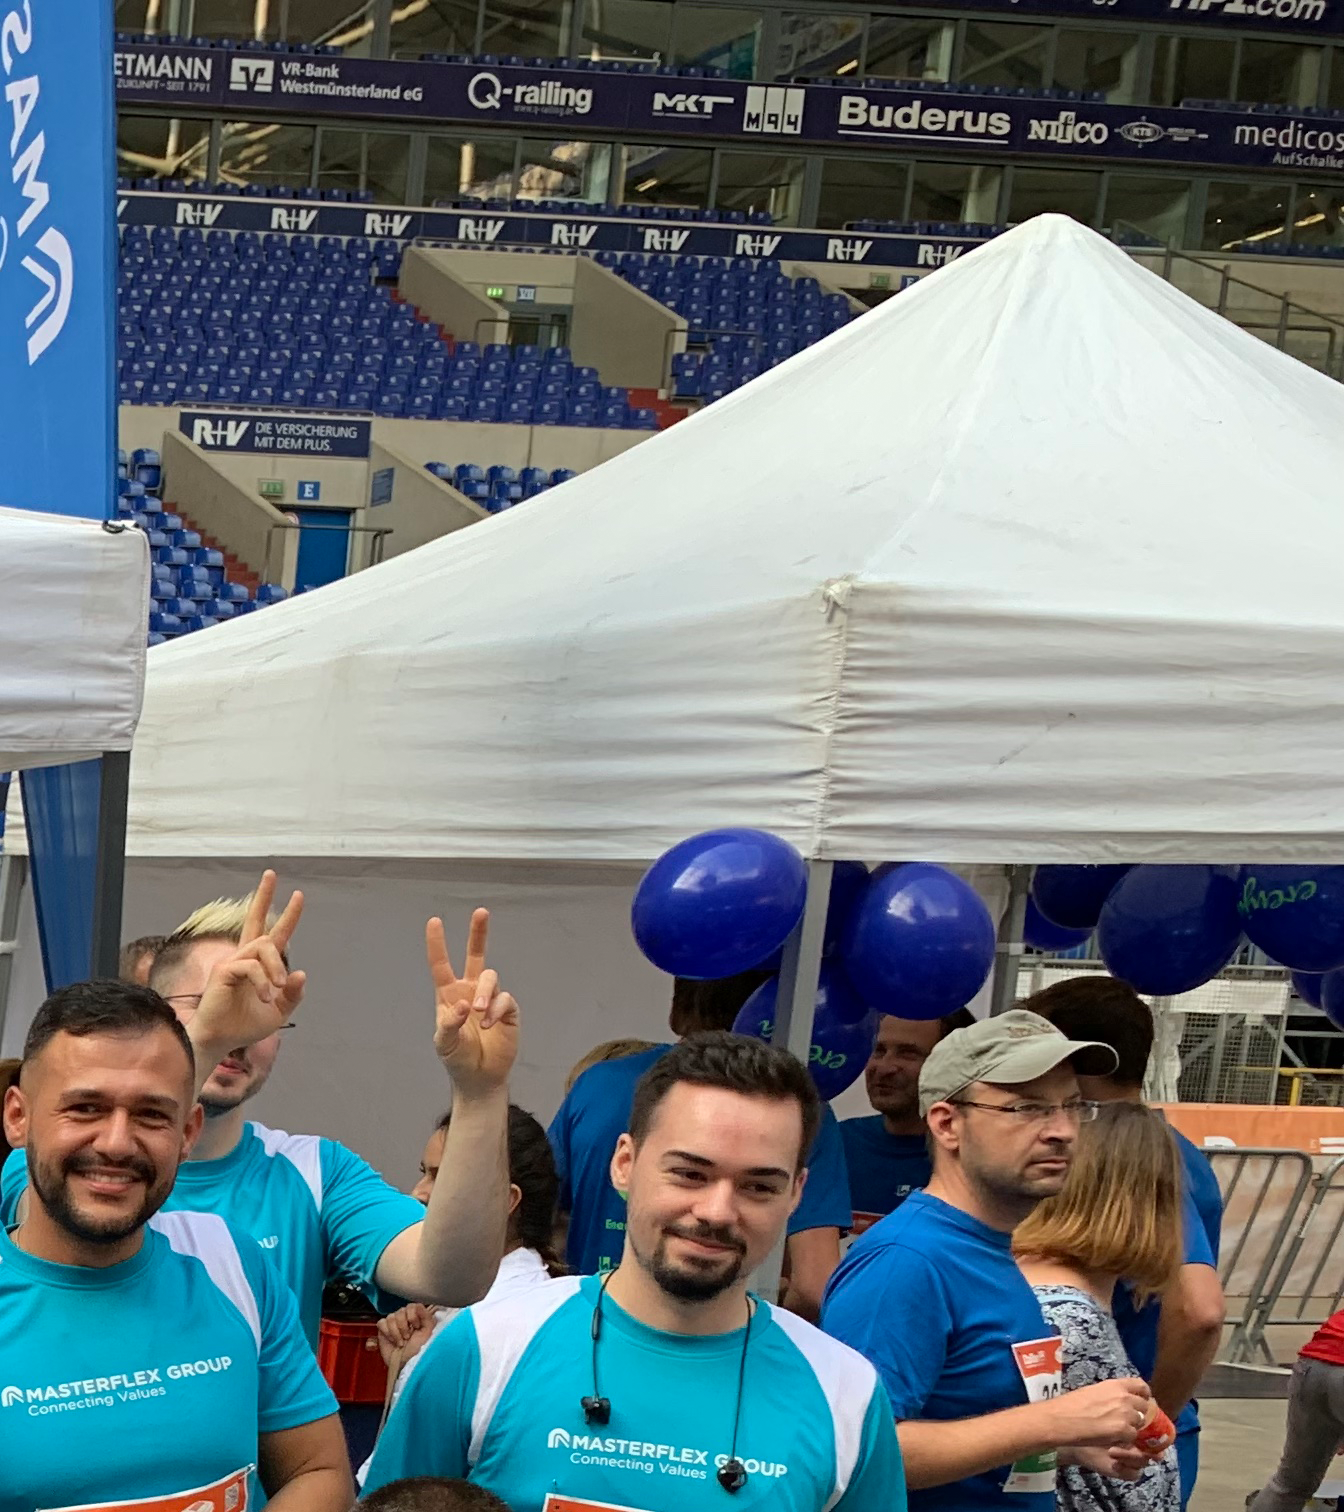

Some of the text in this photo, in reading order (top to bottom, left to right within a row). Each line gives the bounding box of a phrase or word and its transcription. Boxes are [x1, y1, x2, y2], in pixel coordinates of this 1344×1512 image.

[281, 61, 339, 79] VR-Bank
[280, 79, 423, 101] Westmünsterland eG
[468, 72, 593, 114] Q-railing
[653, 92, 735, 113] MKT
[838, 94, 1011, 136] Buderus
[1234, 121, 1344, 152] medicos
[176, 202, 223, 226] R+V
[364, 212, 411, 237] R+V
[551, 223, 599, 247] R+V
[735, 233, 782, 257] R+V
[192, 418, 251, 447] R+V
[255, 421, 358, 440] DIE VERSICHERUNG
[254, 436, 333, 452] MIT DEM PLUS.
[26, 1356, 232, 1404] MASTERFLEX GROUP
[28, 1385, 166, 1417] Connecting Values
[572, 1435, 709, 1466] MASTERFLEX
[570, 1452, 707, 1480] Connecting Values
